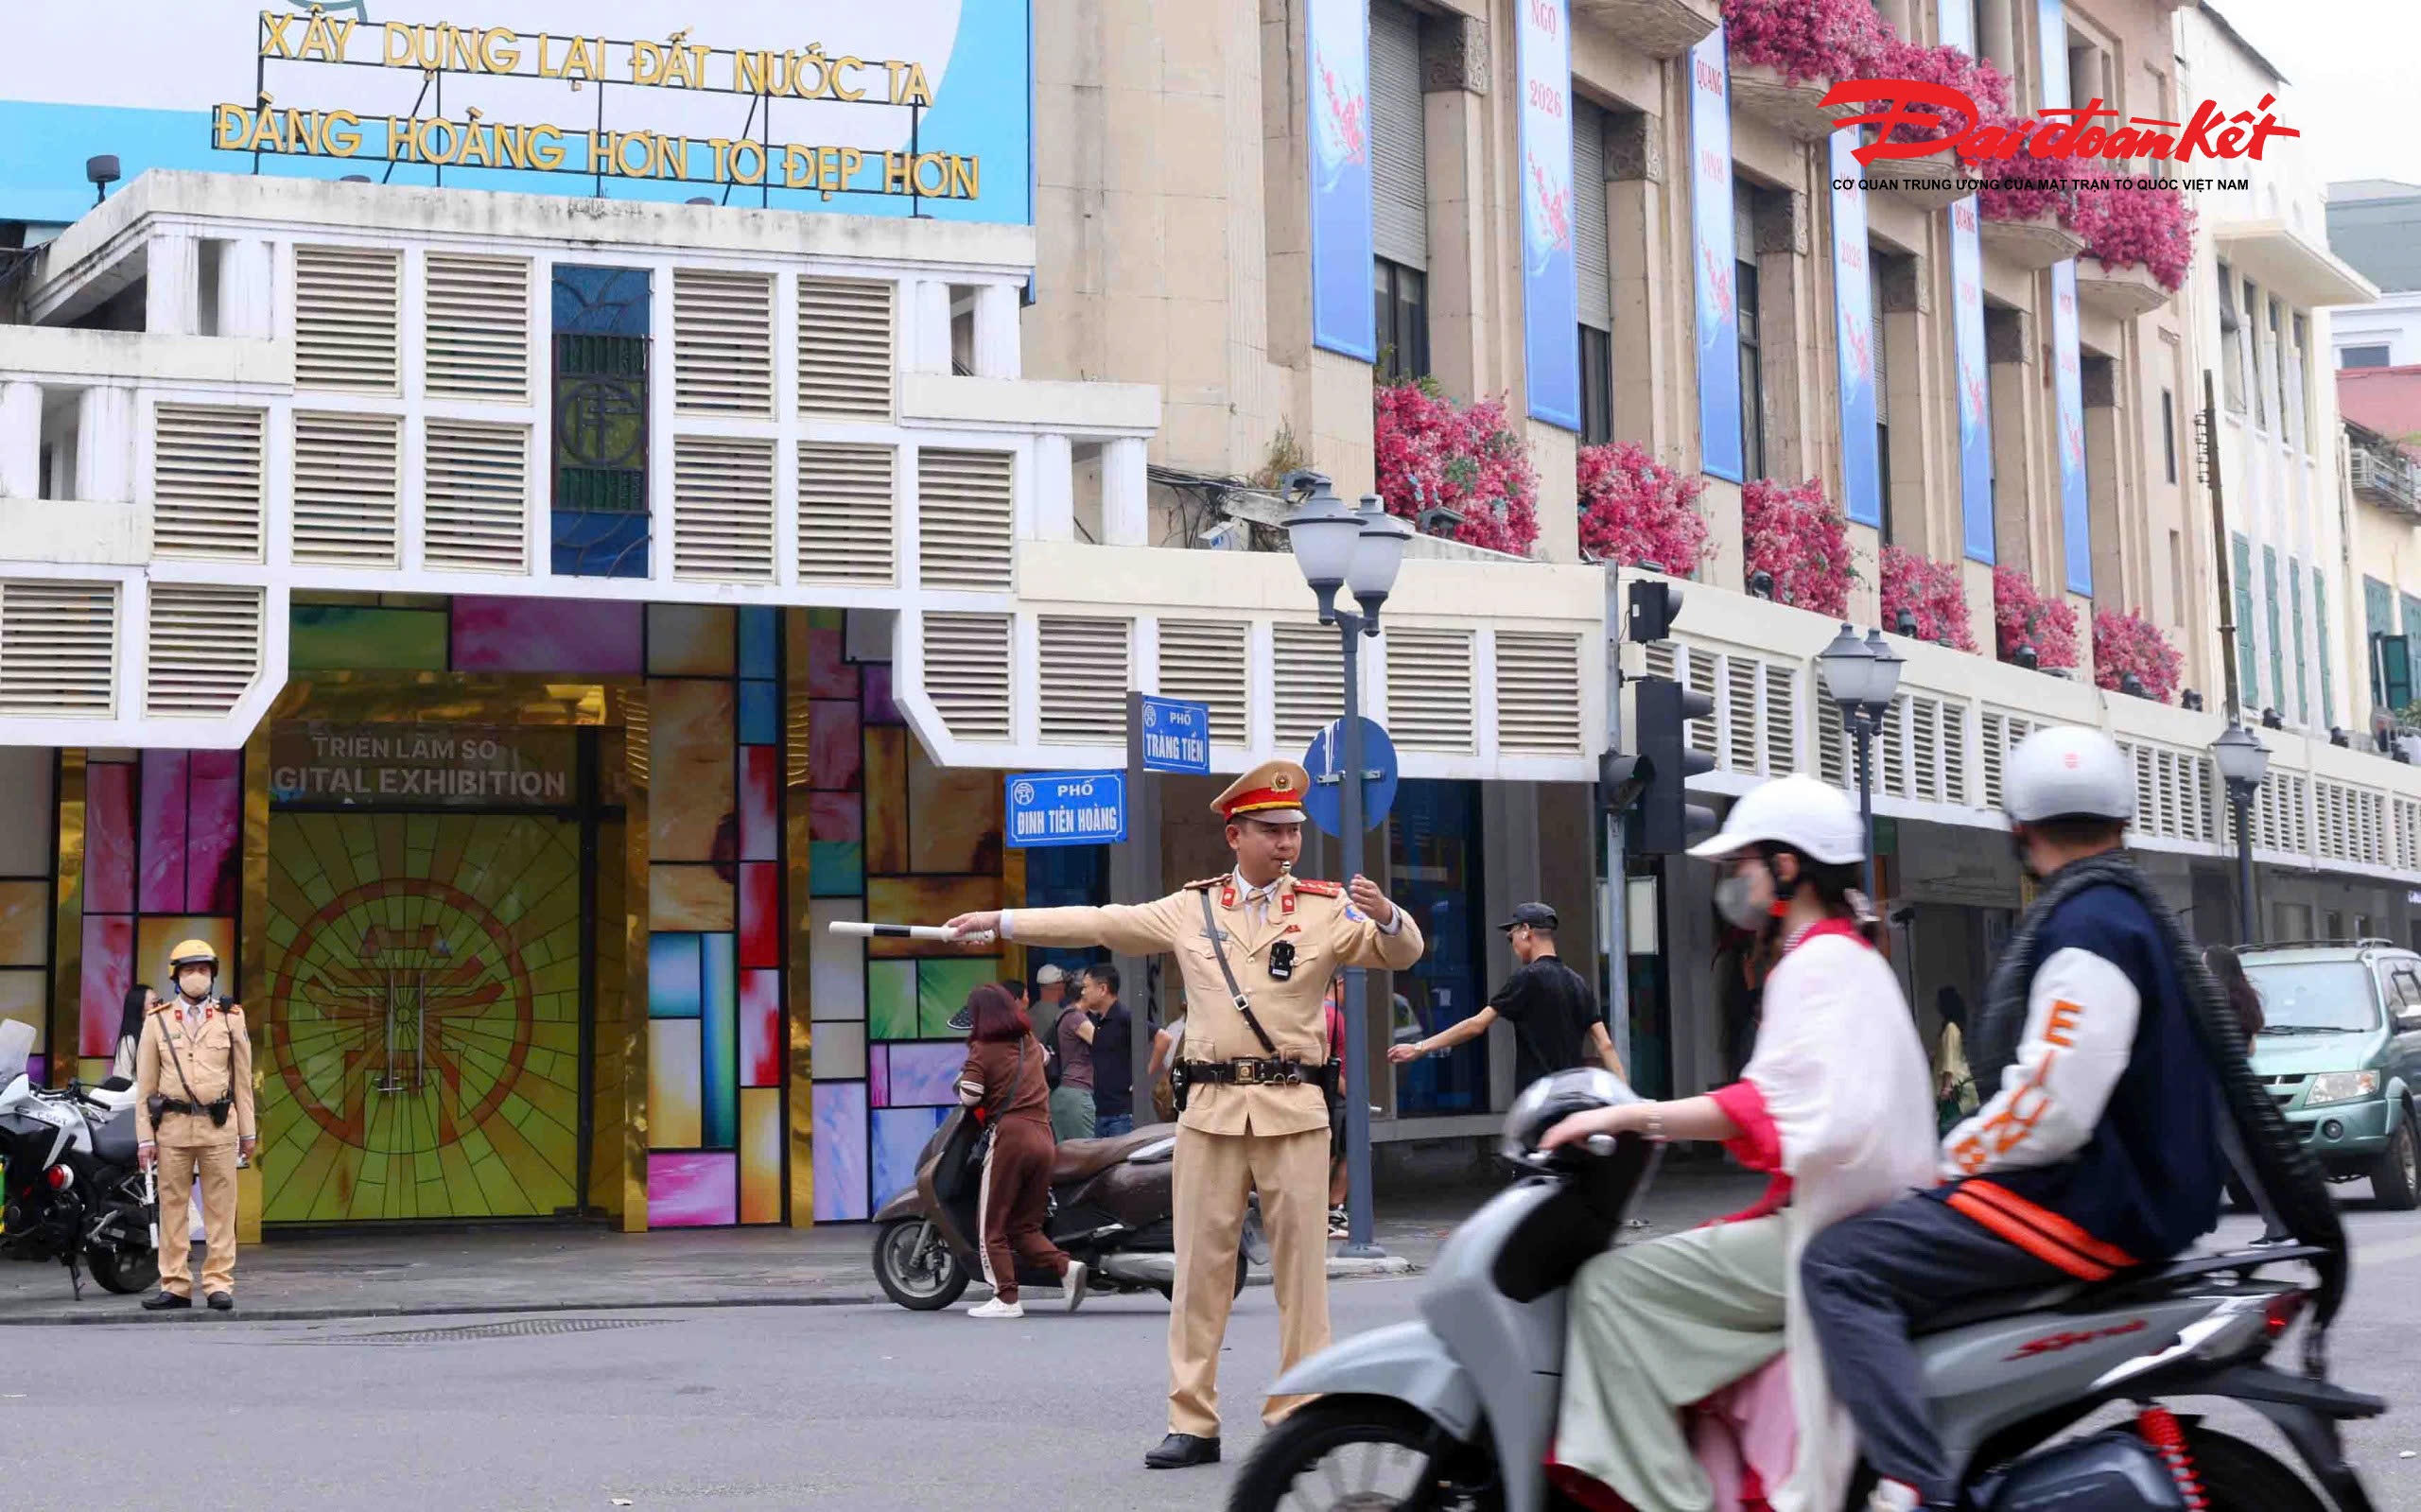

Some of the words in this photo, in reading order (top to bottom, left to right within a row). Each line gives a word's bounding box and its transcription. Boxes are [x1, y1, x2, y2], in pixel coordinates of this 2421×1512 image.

[259, 3, 357, 63] XÂY
[384, 21, 521, 82] DỰNG
[538, 32, 605, 92] LẠI
[628, 26, 711, 90] ĐẤT
[734, 42, 866, 102] NƯỚC
[883, 61, 933, 108] TA
[1697, 60, 1723, 96] QUANG
[1529, 79, 1562, 118] 2026
[214, 91, 363, 157] ĐÀNG
[387, 106, 566, 171] HOÀNG
[587, 129, 688, 181] HƠN
[707, 138, 767, 185] TO
[780, 145, 863, 201] ĐẸP
[885, 150, 980, 200] HƠN
[1170, 709, 1192, 725] PHỐ
[1146, 728, 1180, 760] TRÀNG
[268, 767, 371, 794] GITAL
[379, 769, 566, 796] EXHIBITION
[1057, 778, 1095, 797] PHỐ
[1049, 805, 1074, 833] TIÊN
[1078, 803, 1117, 833] HOÀNG
